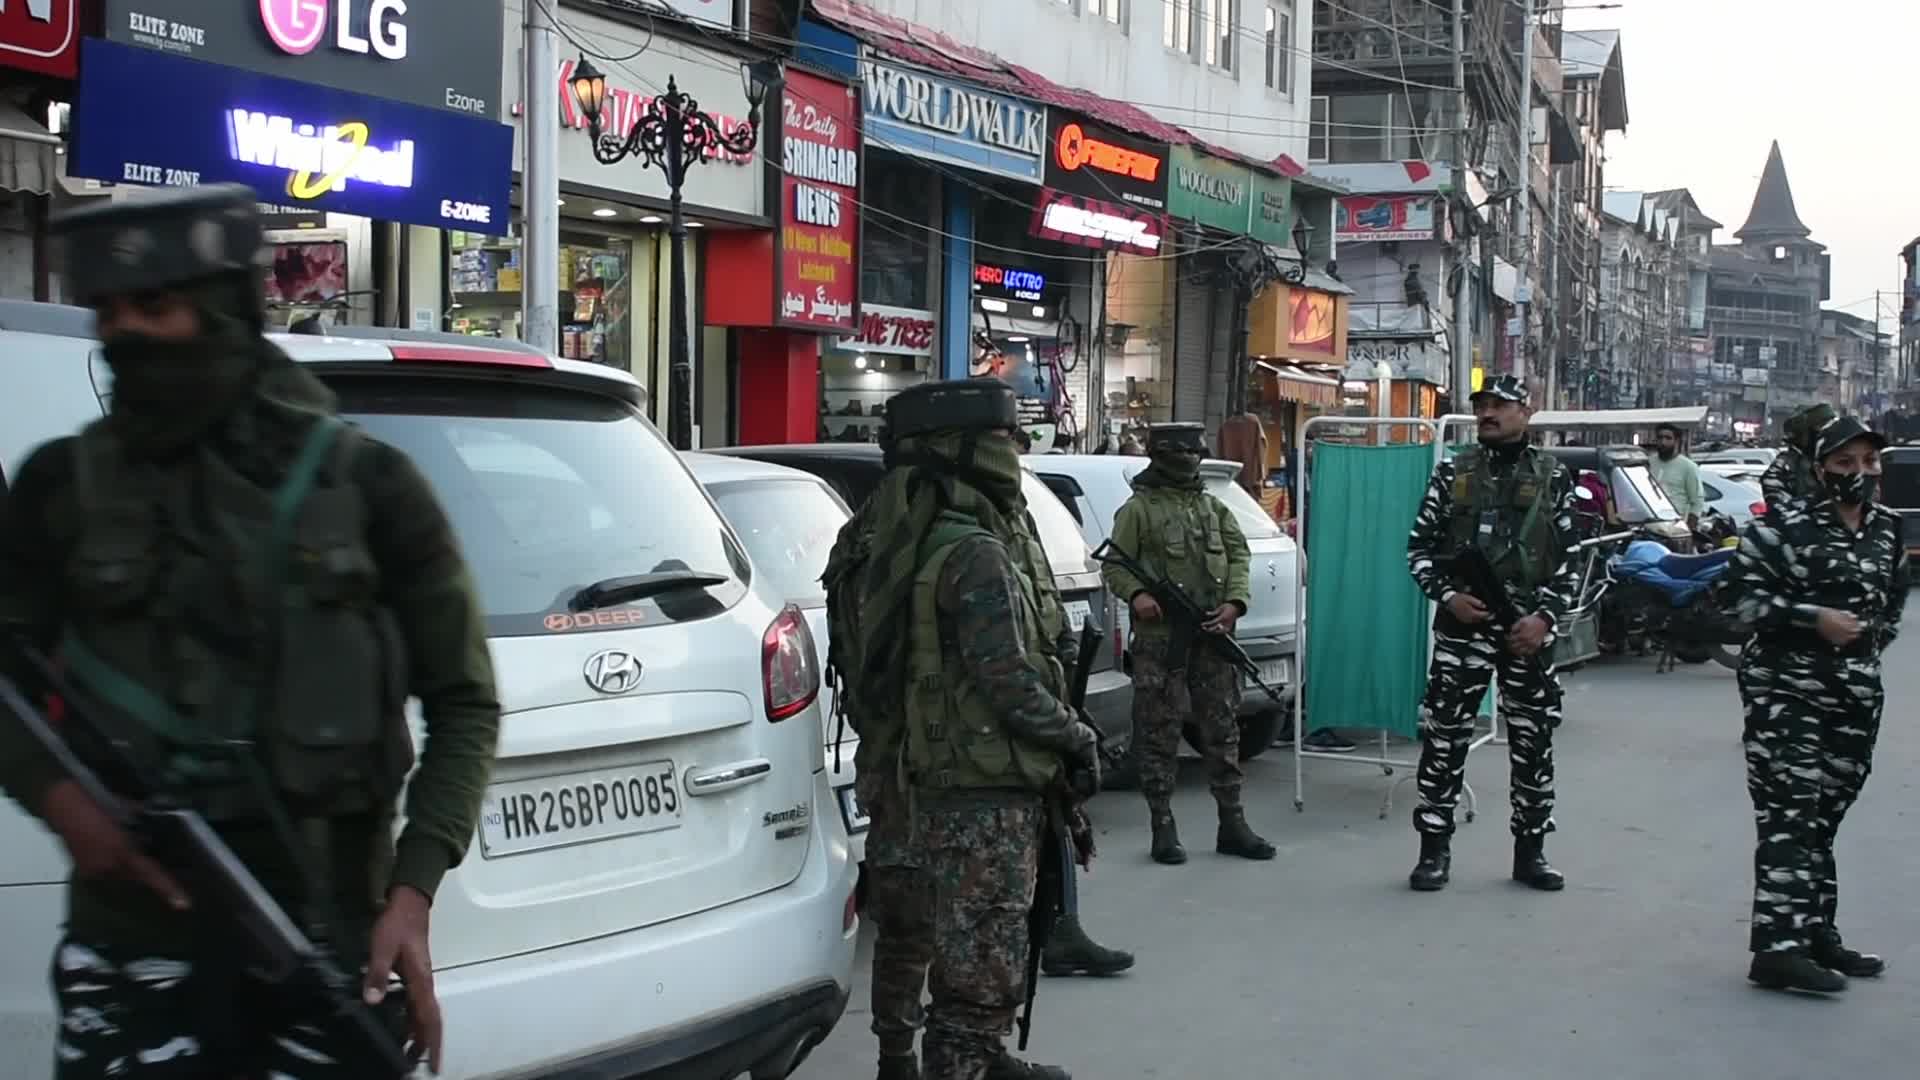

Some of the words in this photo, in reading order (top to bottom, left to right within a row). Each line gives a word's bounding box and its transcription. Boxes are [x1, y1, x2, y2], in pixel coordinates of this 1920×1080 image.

[129, 12, 168, 37] ELITE
[170, 22, 205, 46] ZONE
[337, 0, 407, 60] LG
[445, 87, 486, 114] Ezone
[784, 97, 801, 128] The
[803, 105, 837, 143] Daily
[124, 162, 162, 184] ELITE
[165, 168, 200, 188] ZONE
[783, 136, 857, 188] SRINAGAR
[440, 199, 491, 224] E-ZONE
[796, 183, 840, 228] NEWS
[974, 264, 1003, 284] HERO
[1003, 269, 1044, 291] LECTRO
[502, 773, 677, 840] HR26BP0085
